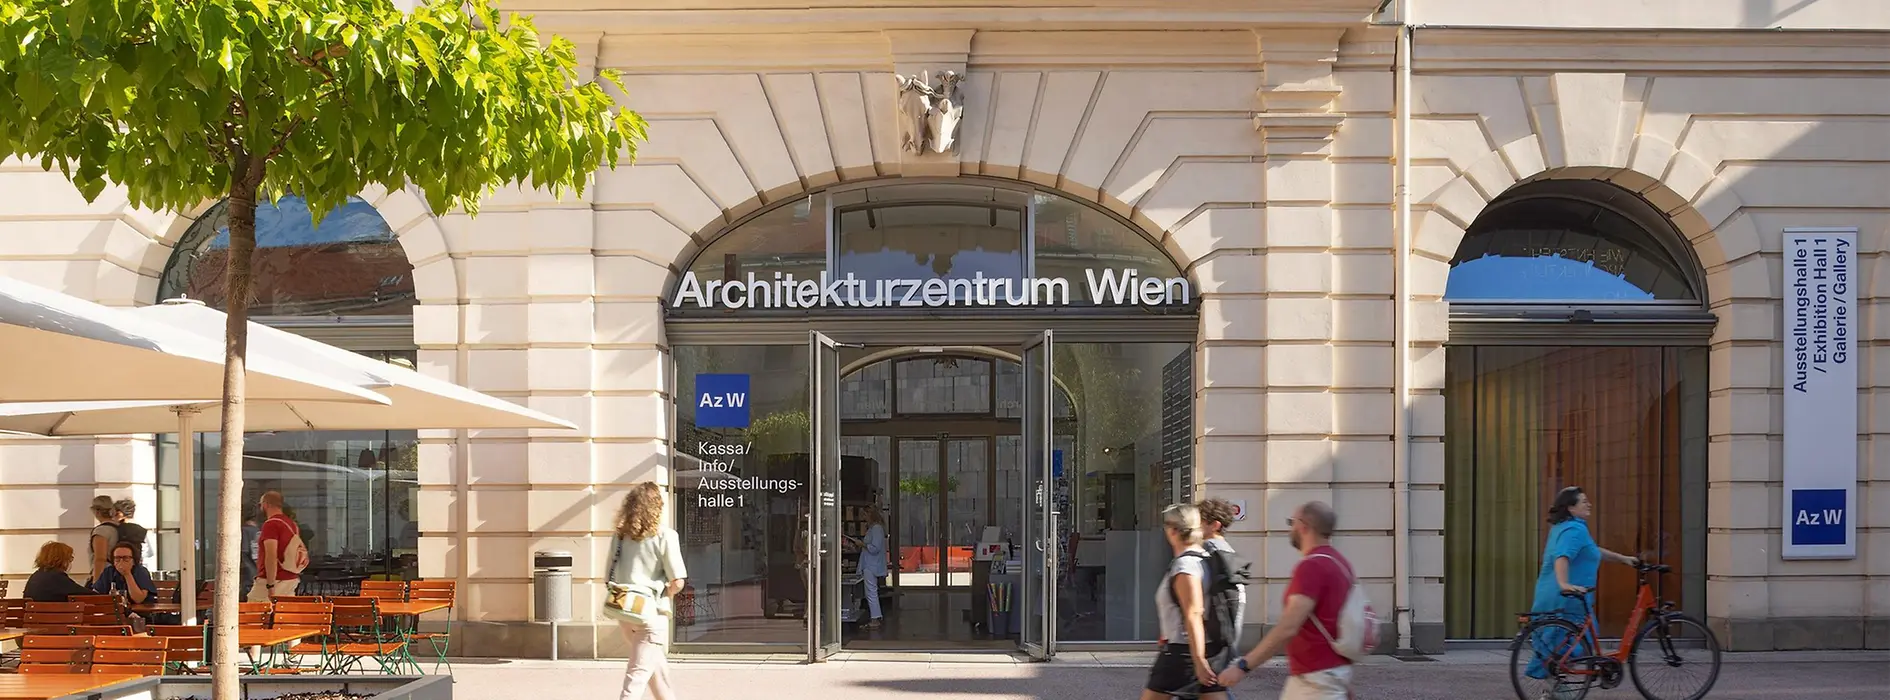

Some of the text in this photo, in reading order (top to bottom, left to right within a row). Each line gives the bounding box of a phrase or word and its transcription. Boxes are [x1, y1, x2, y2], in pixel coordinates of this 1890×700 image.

[1813, 249, 1827, 280] Hall
[672, 267, 1190, 309] Architekturzentrum Wien
[1793, 249, 1810, 393] Ausstellungshalle
[1813, 284, 1827, 363] Exhibition
[697, 476, 803, 493] Ausstellungs-
[698, 494, 744, 508] halle 1
